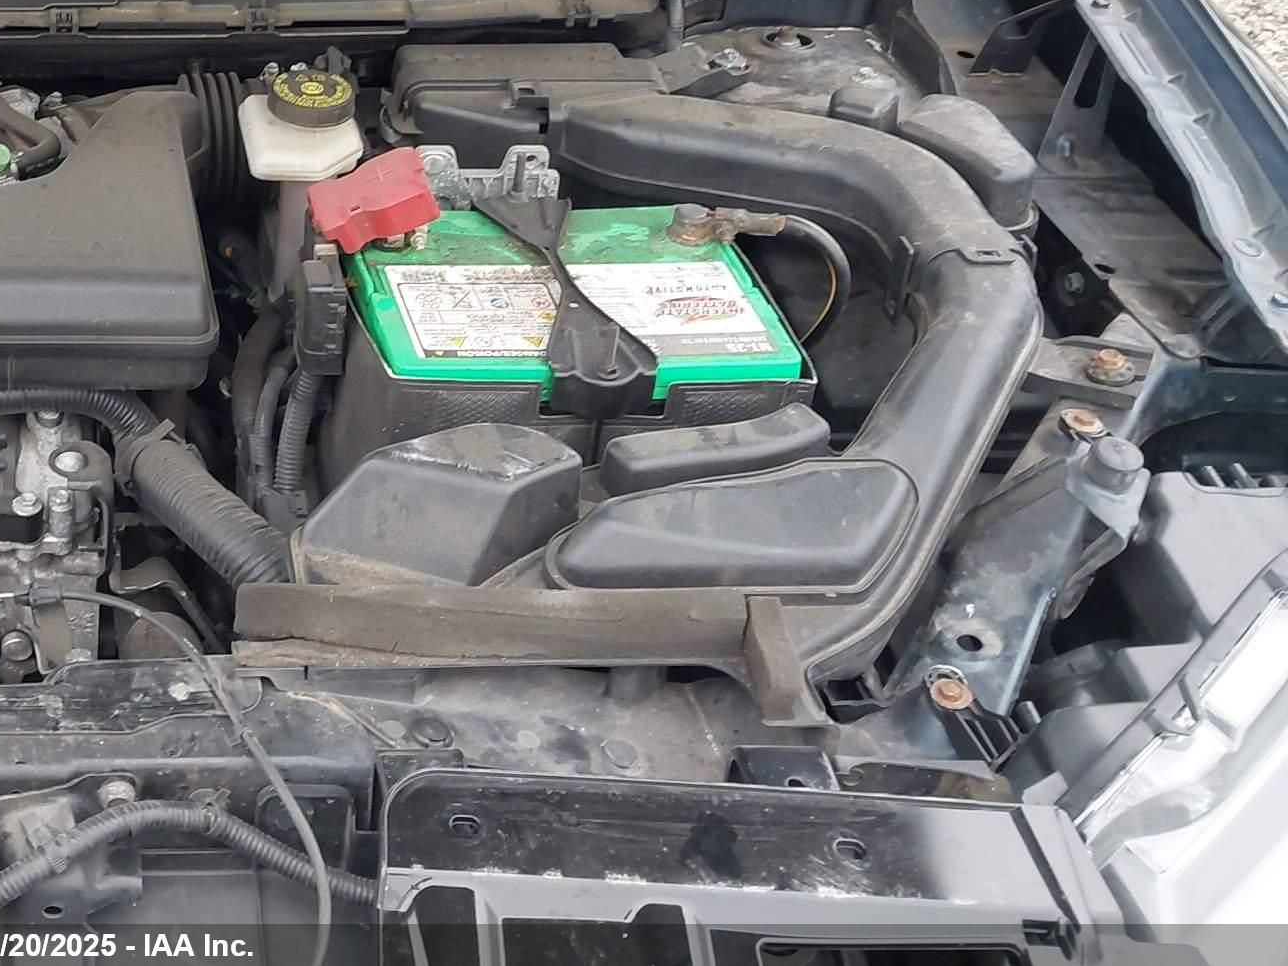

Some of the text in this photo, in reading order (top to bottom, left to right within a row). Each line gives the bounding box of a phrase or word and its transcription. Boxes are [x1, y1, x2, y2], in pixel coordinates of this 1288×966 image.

[646, 285, 727, 296] AUTOMOTIVE
[658, 300, 737, 310] BATTERIES
[655, 307, 745, 318] INTERSTATE
